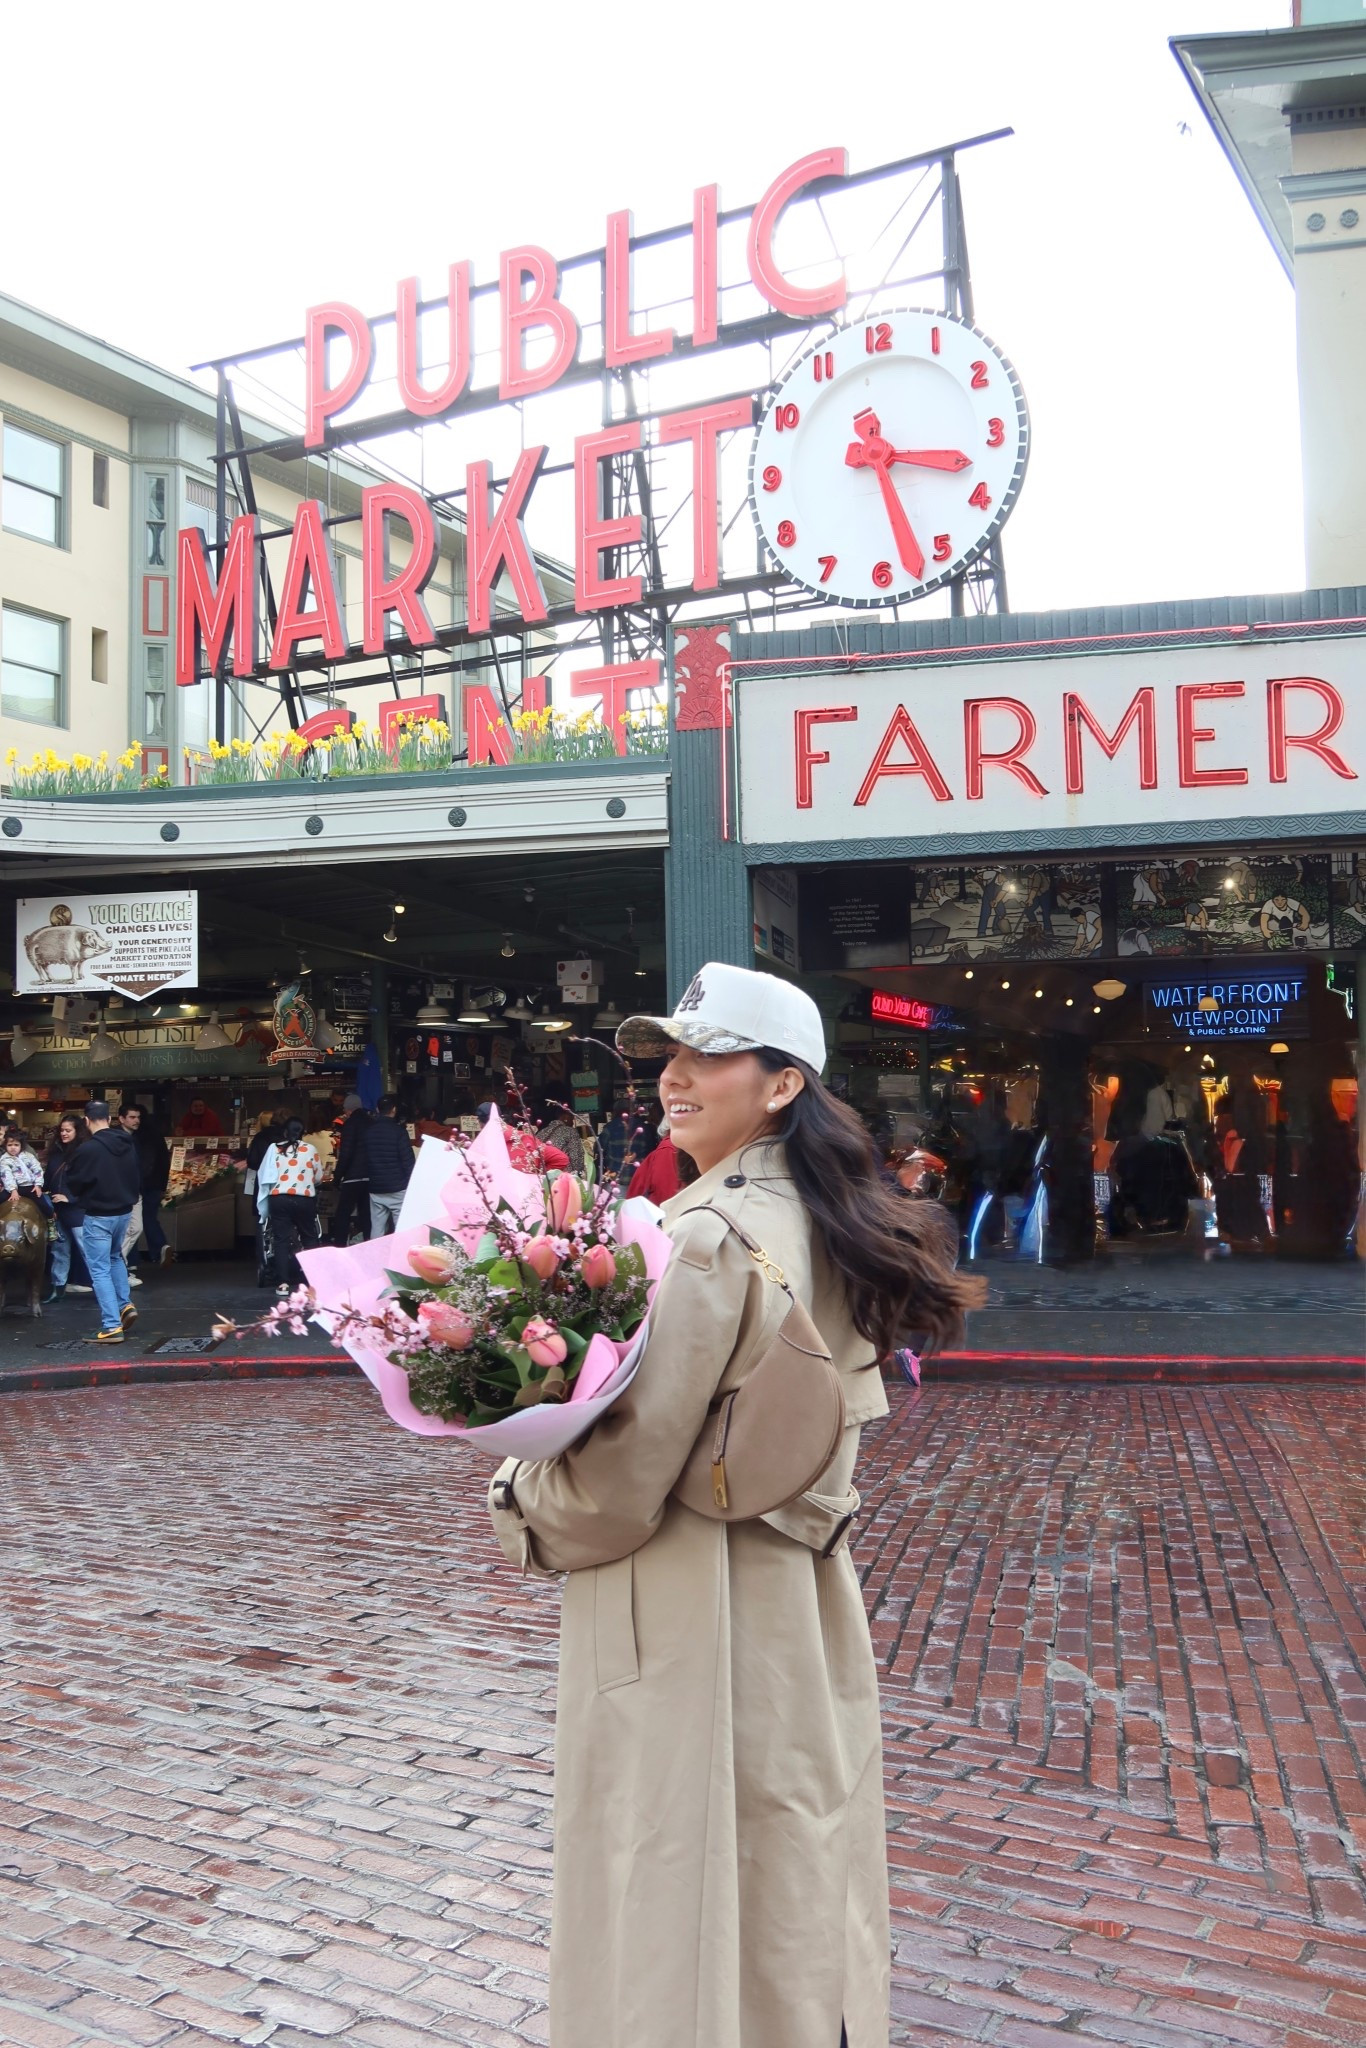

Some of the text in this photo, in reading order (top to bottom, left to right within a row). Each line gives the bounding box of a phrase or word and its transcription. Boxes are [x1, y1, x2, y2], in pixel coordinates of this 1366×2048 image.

[304, 146, 848, 448] PUBLIC
[866, 323, 893, 353] 12
[931, 327, 940, 354] 1
[814, 352, 834, 382] 11
[970, 360, 989, 389] 2
[776, 403, 800, 432] 10
[986, 418, 1005, 447] 3
[762, 465, 783, 492] 9
[968, 482, 992, 510] 4
[176, 396, 757, 687] MARKET
[777, 520, 797, 548] 8
[932, 534, 952, 562] 5
[818, 555, 838, 582] 7
[872, 561, 893, 588] 6
[794, 676, 1358, 809] FARMER
[89, 901, 192, 924] YOUR CHANGE
[106, 923, 192, 934] CHANGES LIVES!
[107, 974, 145, 982] DONATE
[679, 974, 705, 1012] LA
[1152, 982, 1302, 1008] WATERFRONT
[1172, 1008, 1284, 1027] VIEWPOINT
